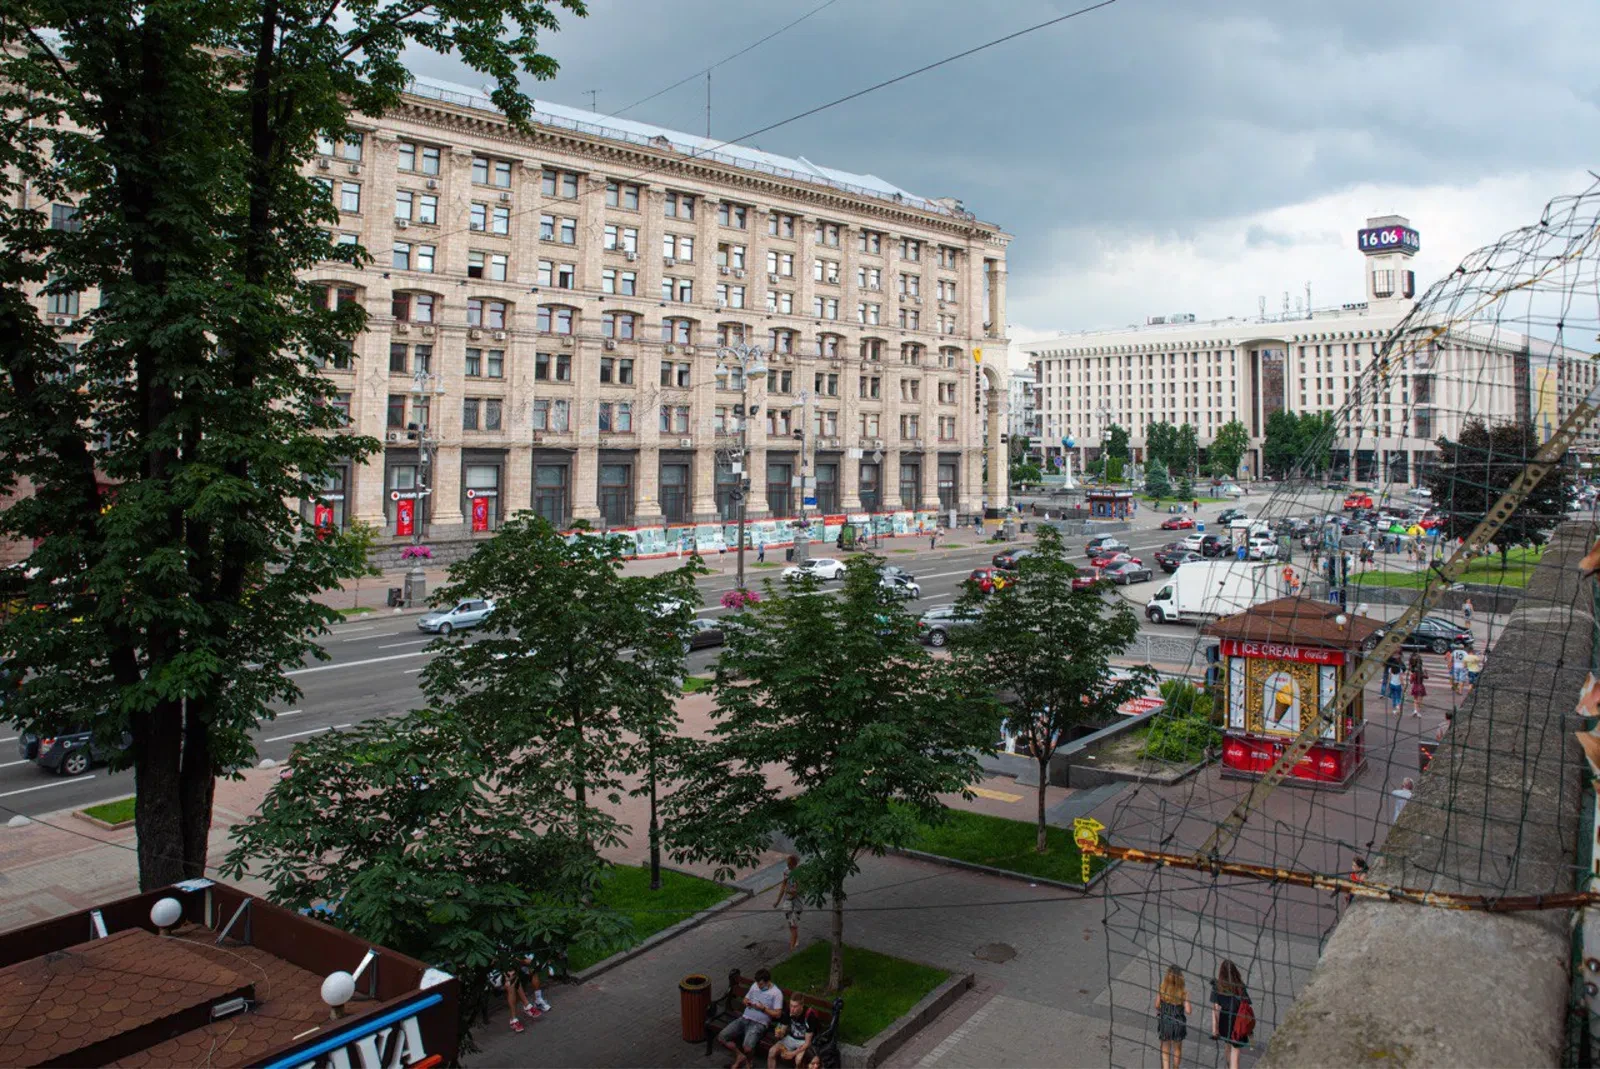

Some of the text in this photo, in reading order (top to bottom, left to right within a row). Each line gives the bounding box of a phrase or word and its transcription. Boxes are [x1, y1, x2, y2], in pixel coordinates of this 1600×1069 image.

[1362, 230, 1398, 246] 16 06
[1242, 643, 1258, 654] ICE
[1262, 645, 1298, 658] CREAM
